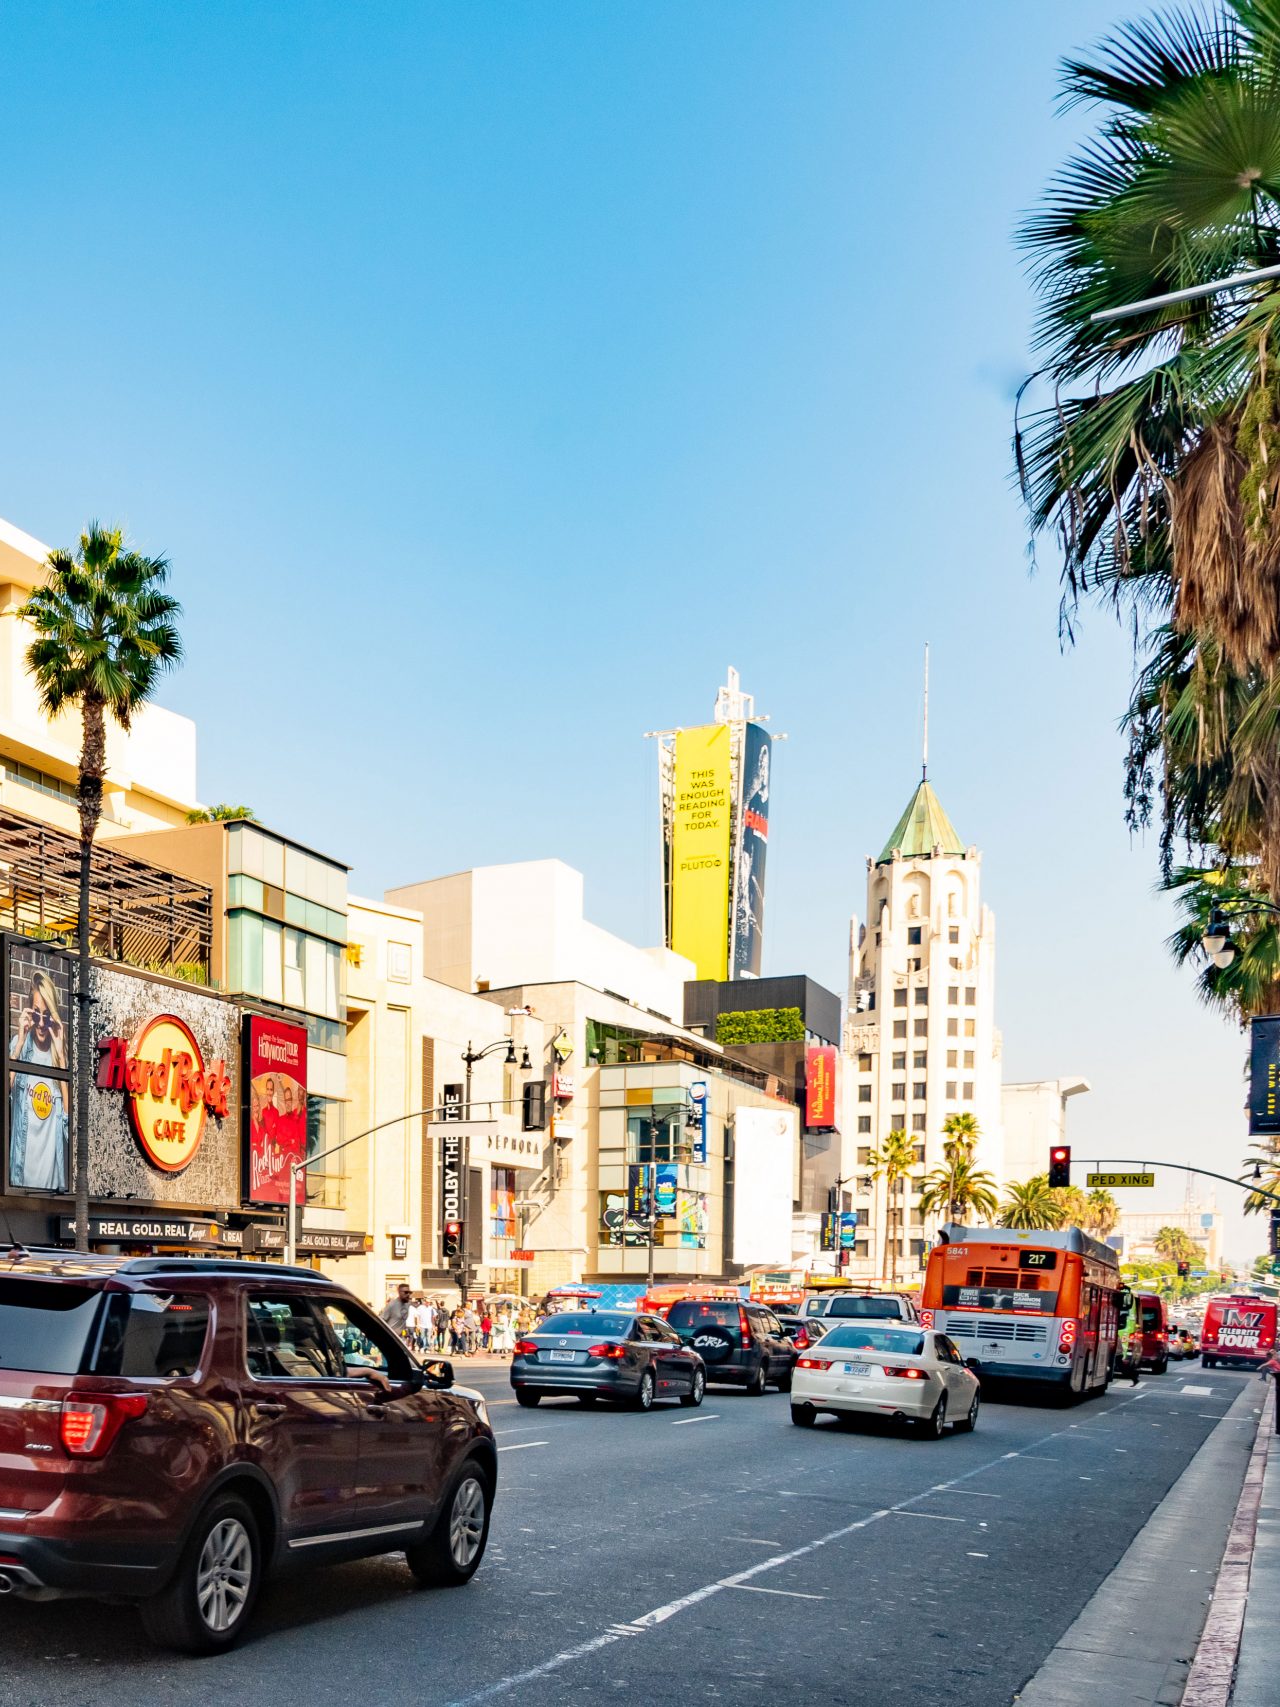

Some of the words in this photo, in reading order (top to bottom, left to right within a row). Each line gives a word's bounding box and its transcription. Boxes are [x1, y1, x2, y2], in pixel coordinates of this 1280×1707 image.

[691, 770, 714, 779] THIS
[691, 780, 714, 789] WAS
[681, 789, 724, 801] ENOUGH
[679, 799, 725, 811] READING
[691, 811, 711, 819] FOR
[685, 820, 719, 831] TODAY.
[681, 860, 712, 871] PLUTO
[95, 1036, 173, 1097] Hard
[170, 1051, 231, 1118] Rock
[1268, 1064, 1276, 1088] WITH
[1267, 1093, 1275, 1115] FEST
[153, 1119, 186, 1144] CAFE
[445, 1093, 460, 1167] THETRE
[1091, 1176, 1116, 1185] PED
[1120, 1175, 1149, 1185] XING
[445, 1169, 459, 1220] DOLBY
[99, 1222, 130, 1235] REAL
[132, 1224, 163, 1236] GOLD.
[164, 1225, 187, 1237] REAL
[331, 1236, 345, 1247] REAL
[947, 1247, 968, 1255] 5841
[1028, 1254, 1046, 1264] 217
[1216, 1308, 1265, 1328] TMZ
[1218, 1327, 1261, 1337] CELEBRITY
[1218, 1333, 1260, 1348] TOUR
